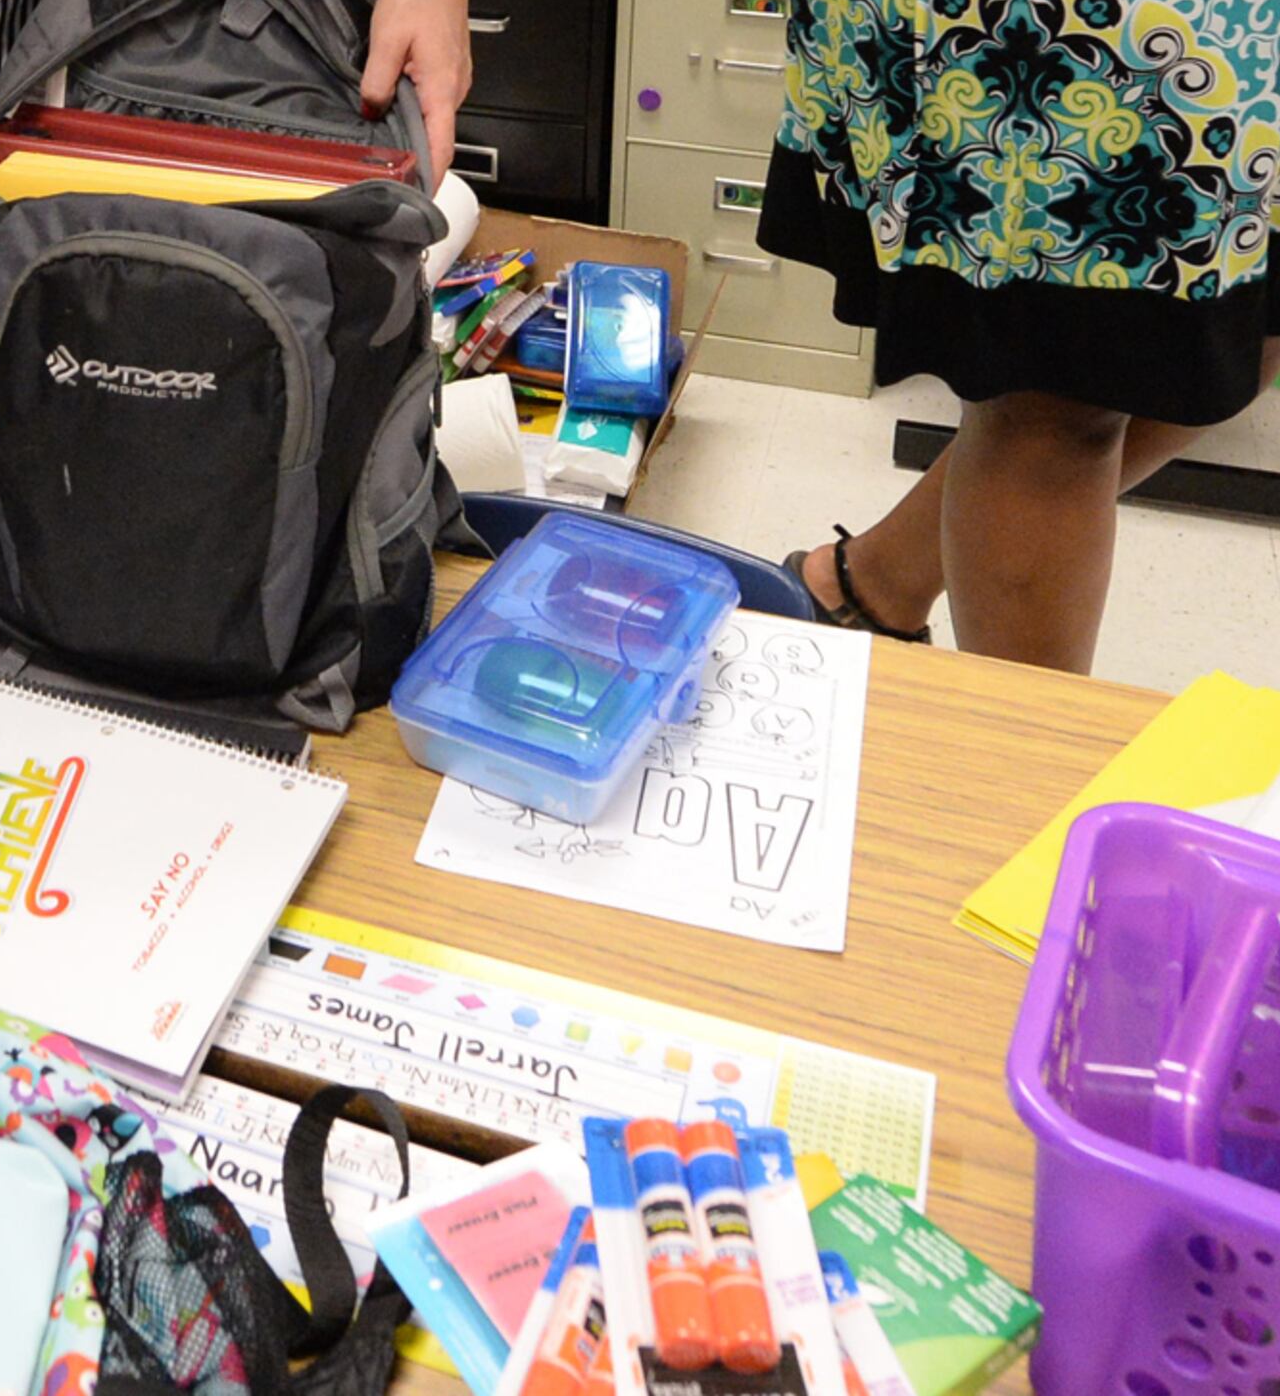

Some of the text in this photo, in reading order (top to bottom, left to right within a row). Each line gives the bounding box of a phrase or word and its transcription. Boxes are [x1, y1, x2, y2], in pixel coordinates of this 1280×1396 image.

[82, 359, 217, 393] OUTDOOR
[140, 851, 190, 921] SAY NO
[307, 992, 579, 1101] Jarrell James
